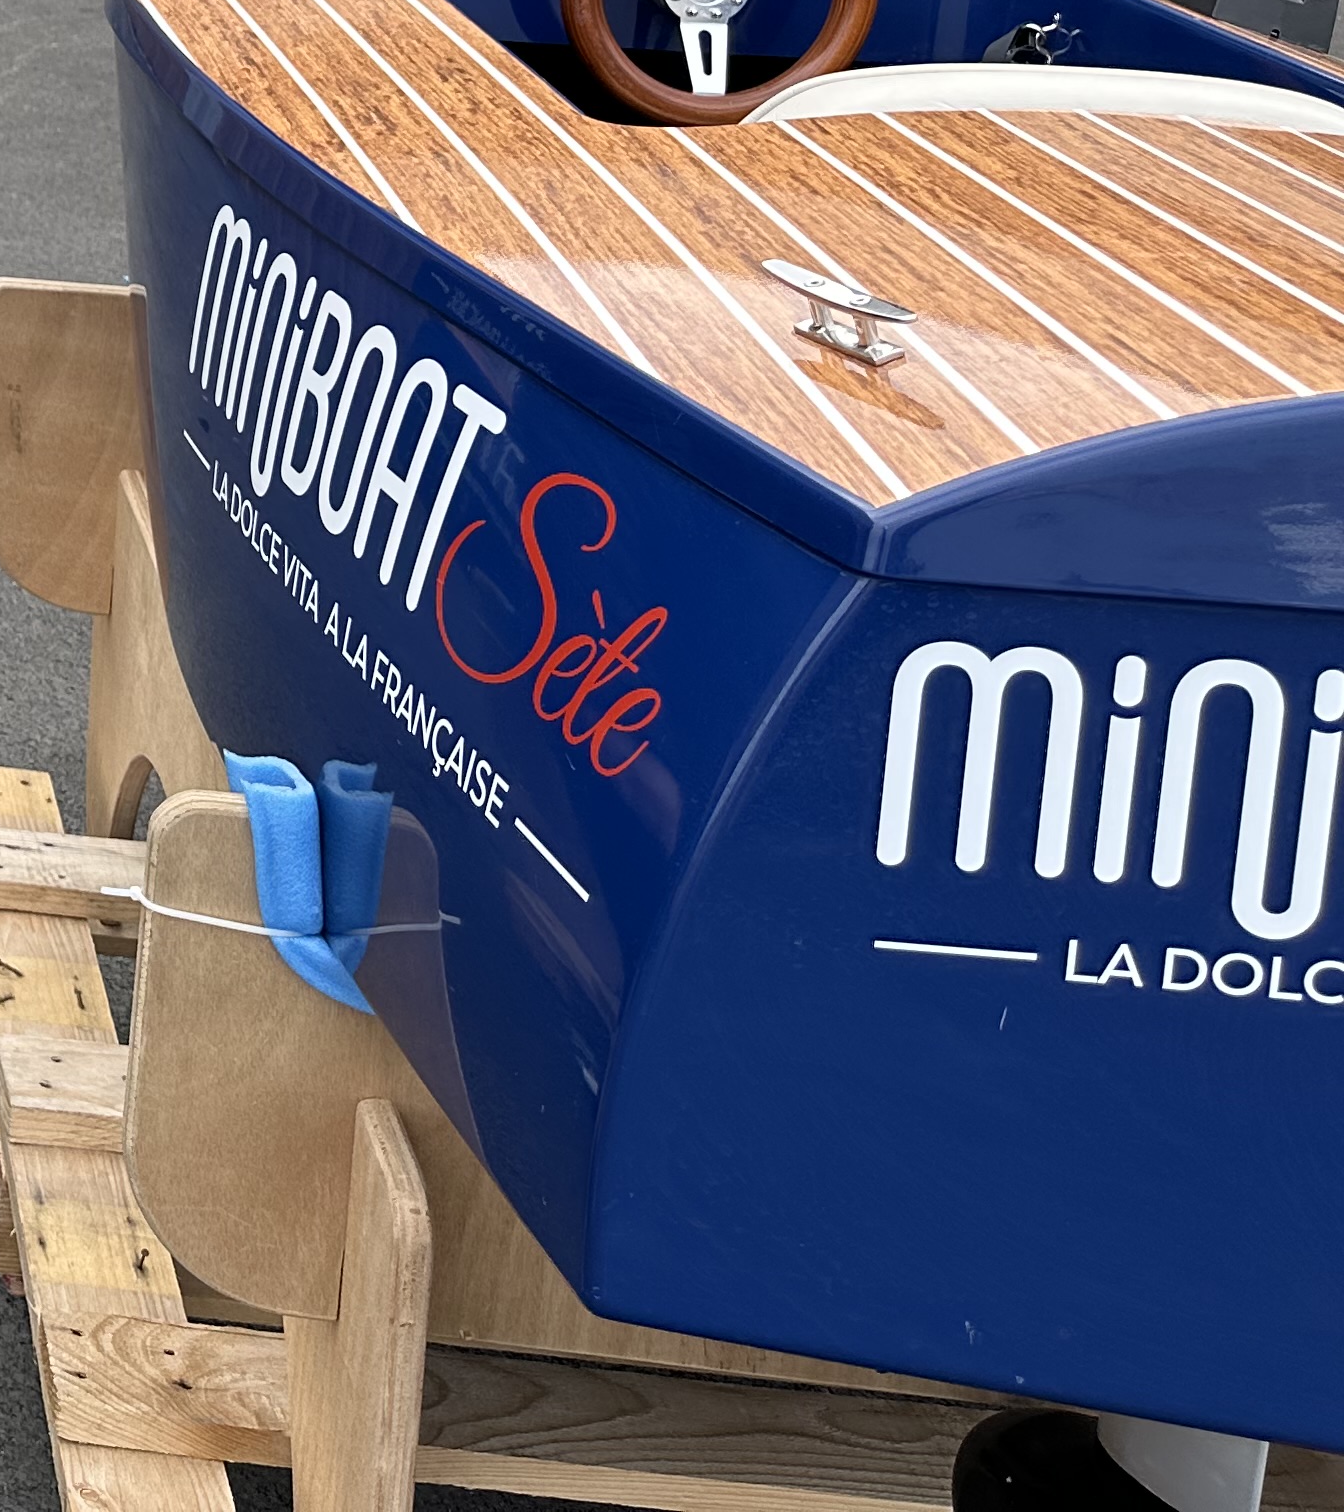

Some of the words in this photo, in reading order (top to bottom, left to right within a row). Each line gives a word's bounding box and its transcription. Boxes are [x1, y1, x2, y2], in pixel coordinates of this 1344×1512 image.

[212, 460, 229, 511] LA
[229, 483, 282, 575] DOLCE
[283, 545, 319, 624] VITA
[324, 602, 339, 647] A
[341, 617, 368, 681] LA
[370, 649, 510, 829] FRANÇAISE
[436, 472, 668, 777] Sète
[1064, 939, 1144, 988] LA
